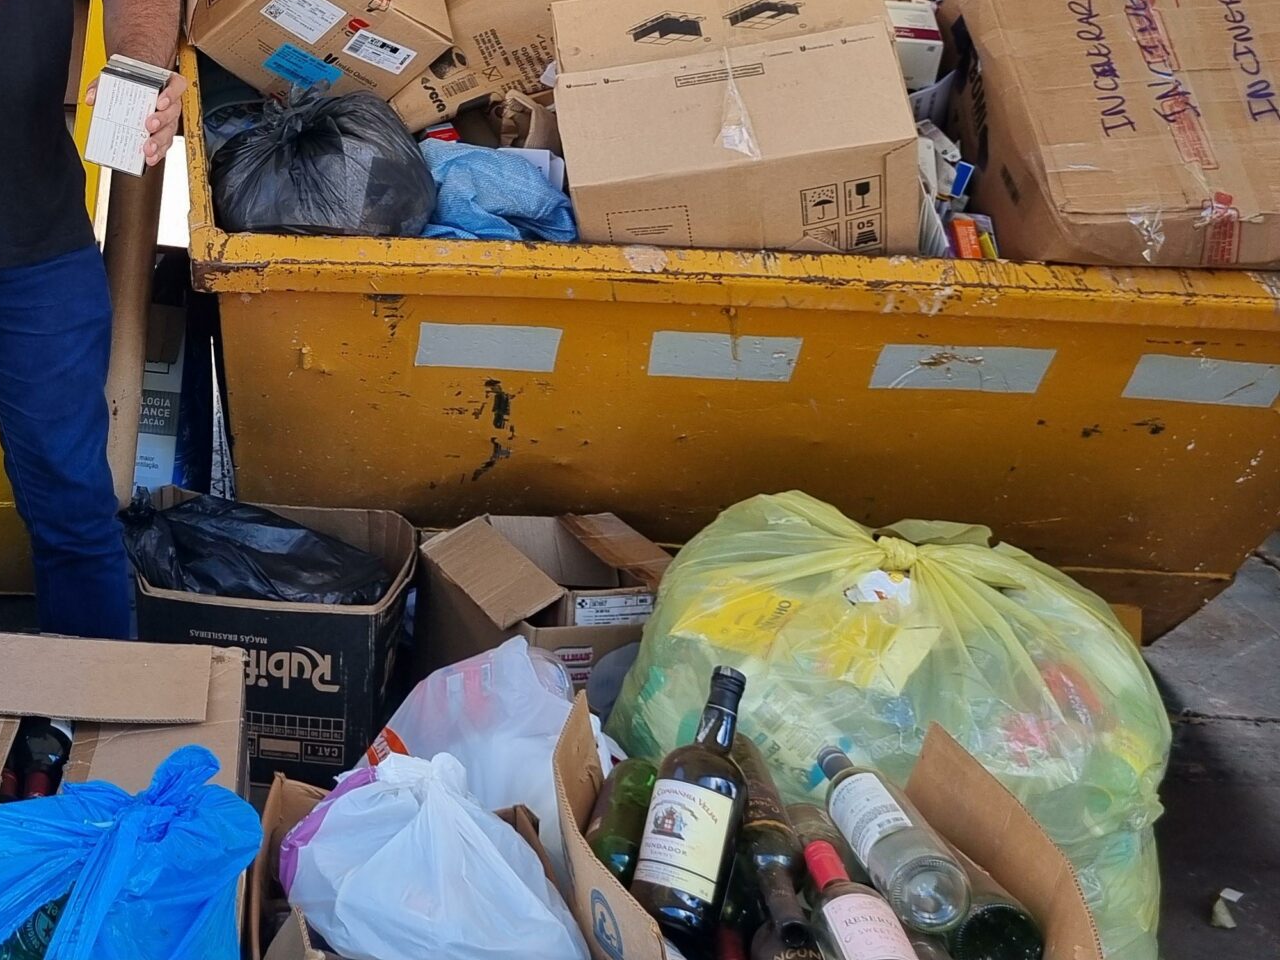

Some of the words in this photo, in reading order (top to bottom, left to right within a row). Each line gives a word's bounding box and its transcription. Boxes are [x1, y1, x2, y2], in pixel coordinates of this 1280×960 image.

[857, 219, 875, 229] 05
[189, 629, 238, 642] BRASILEIRAS
[245, 645, 340, 693] Rubif
[317, 746, 339, 757] CAT.
